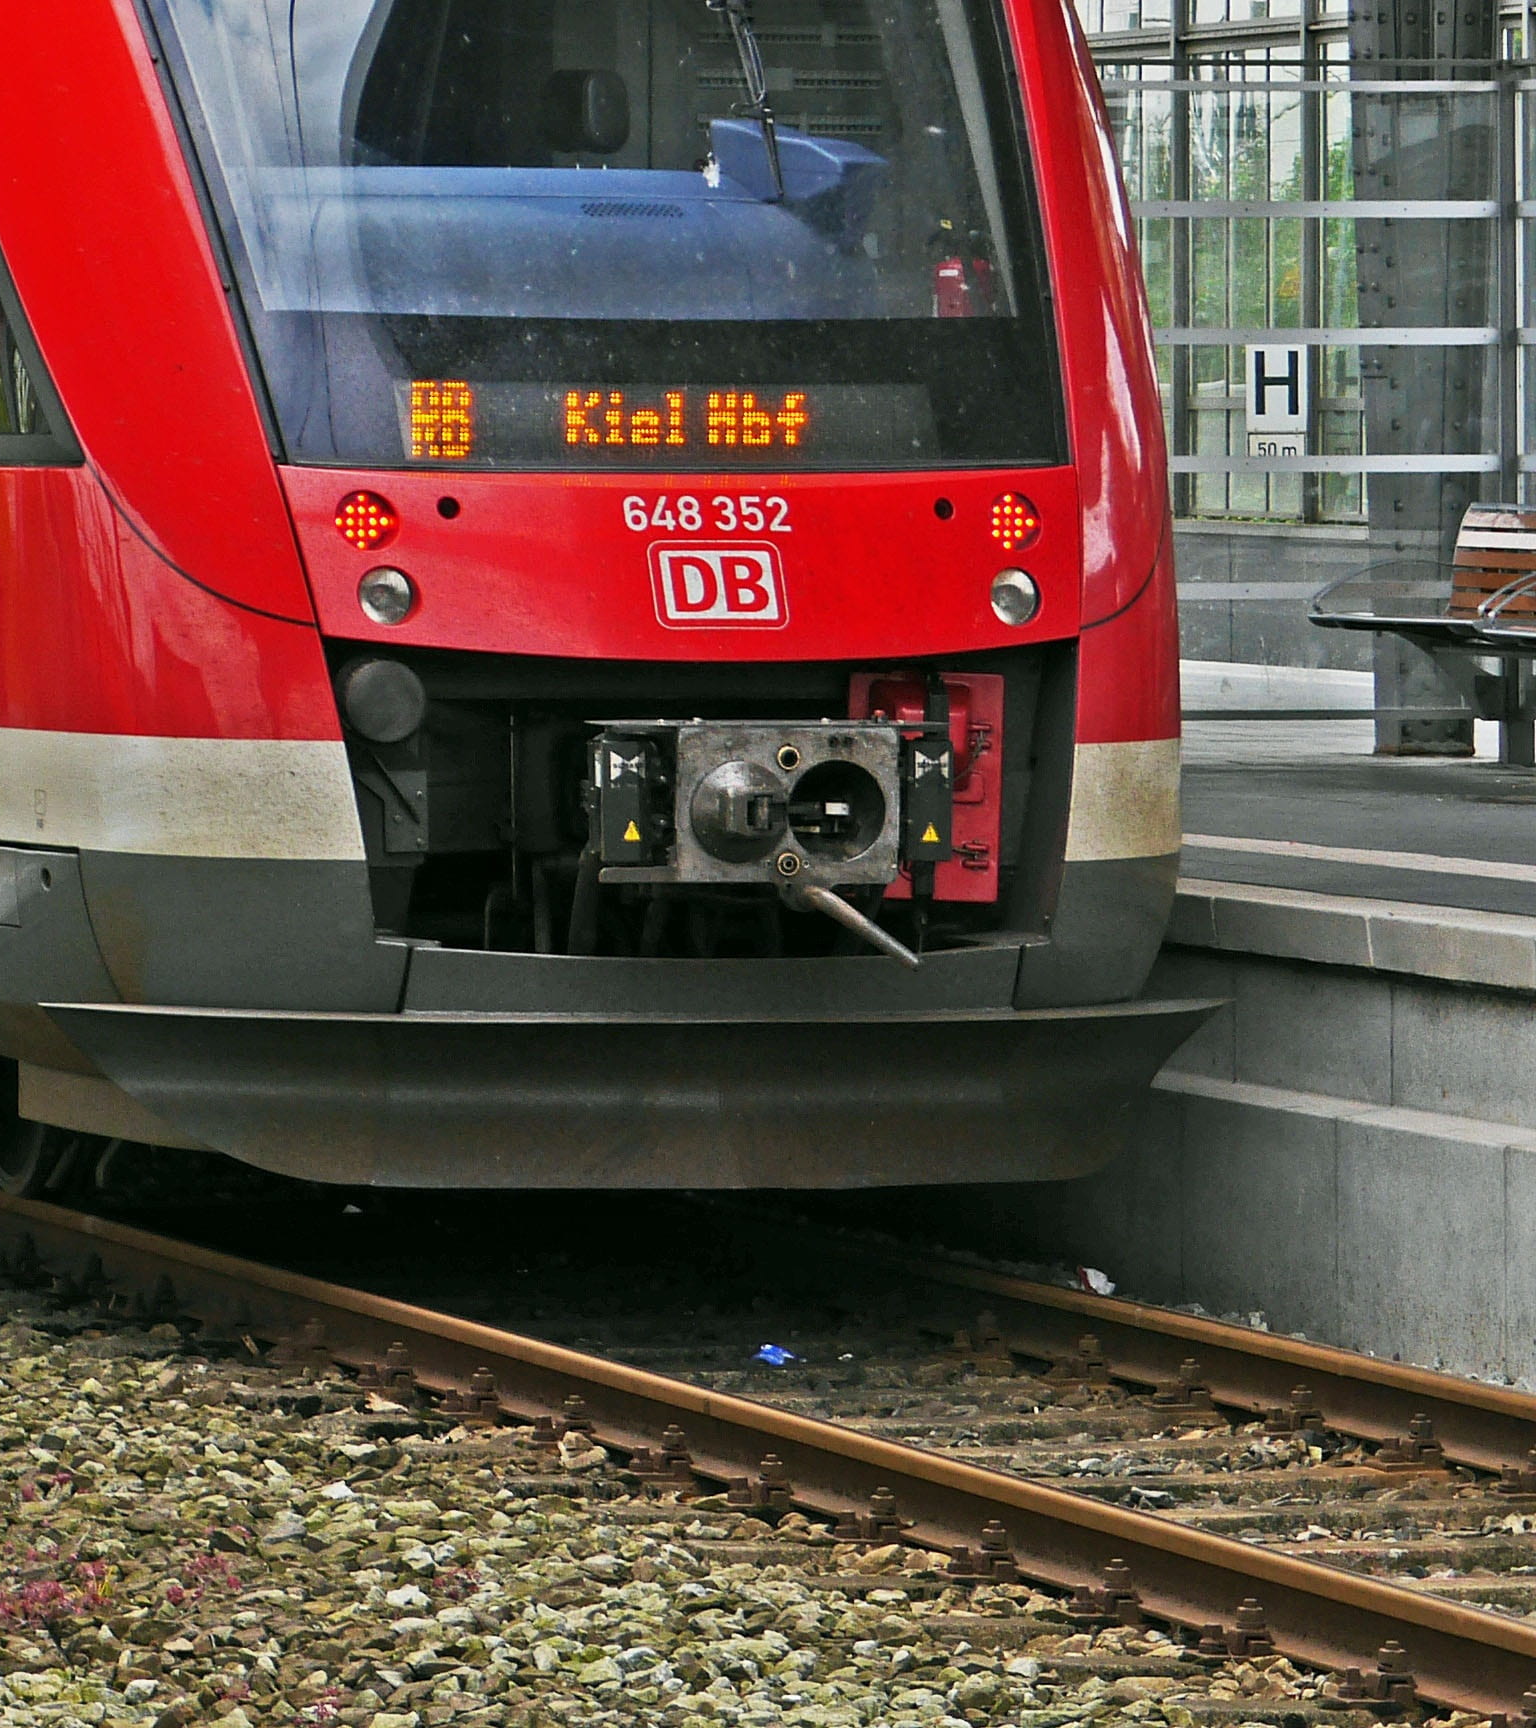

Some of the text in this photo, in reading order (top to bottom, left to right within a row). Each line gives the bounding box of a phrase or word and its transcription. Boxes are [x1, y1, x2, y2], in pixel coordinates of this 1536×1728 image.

[1254, 350, 1298, 415] H
[411, 381, 806, 457] RB Kiel Hbf
[1258, 442, 1297, 456] 50 m
[623, 496, 792, 532] 648 352
[659, 551, 779, 620] DB
